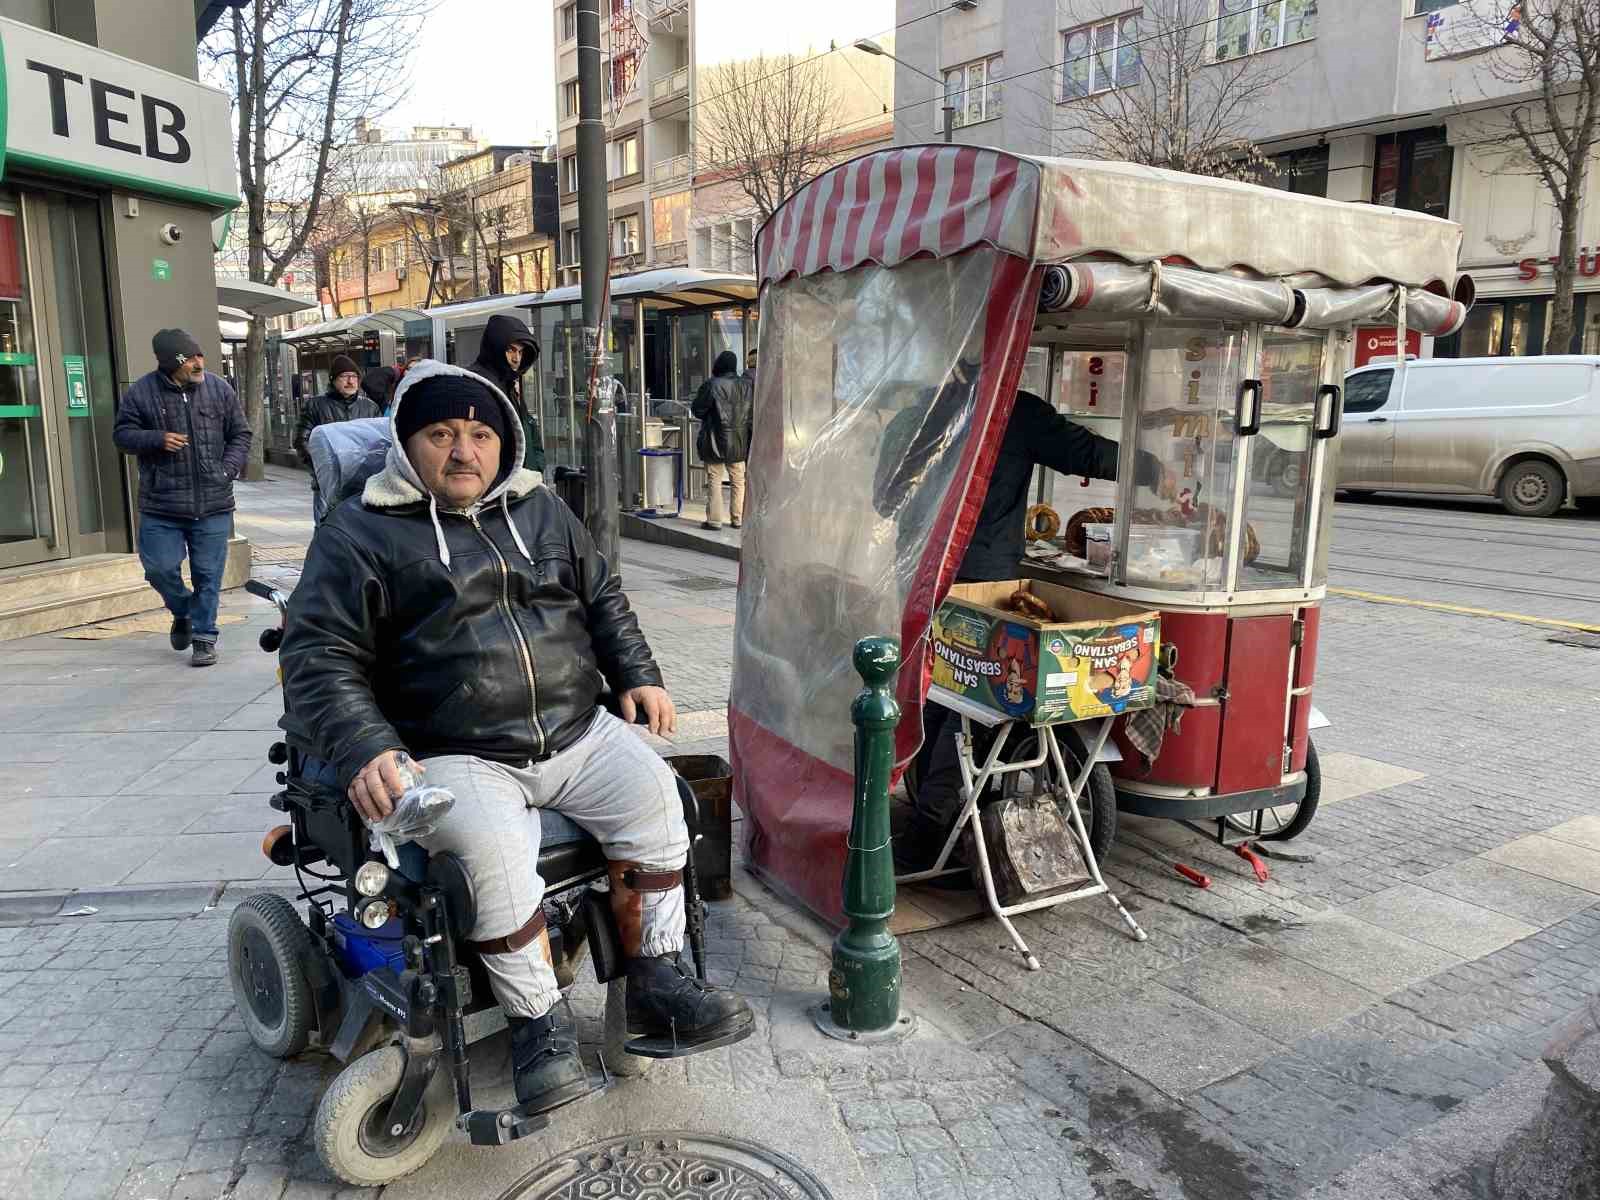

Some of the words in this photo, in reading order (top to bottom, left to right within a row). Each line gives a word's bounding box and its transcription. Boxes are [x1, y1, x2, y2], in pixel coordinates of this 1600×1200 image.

[26, 59, 191, 163] TEB
[1074, 636, 1138, 657] SEBASTIANO
[935, 640, 1001, 676] SEBASTIANO
[1092, 655, 1118, 669] SAN
[953, 668, 978, 688] SAN
